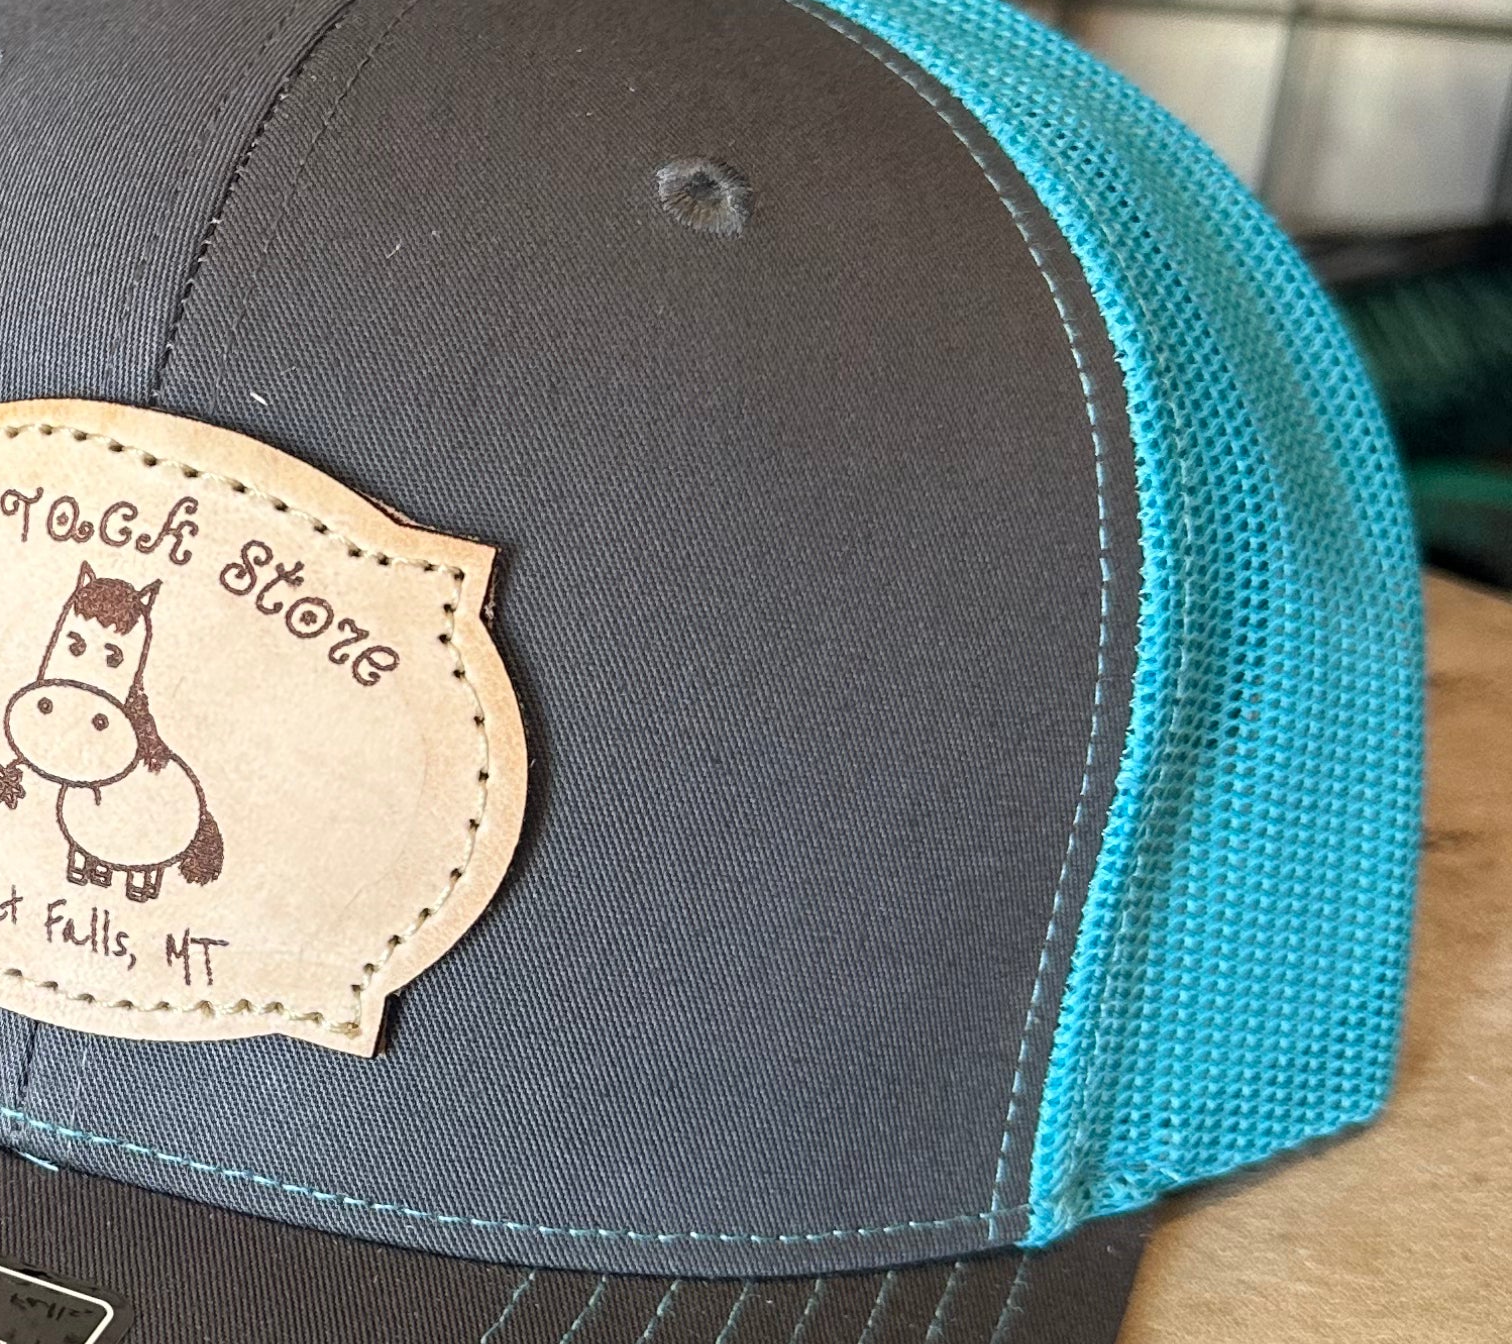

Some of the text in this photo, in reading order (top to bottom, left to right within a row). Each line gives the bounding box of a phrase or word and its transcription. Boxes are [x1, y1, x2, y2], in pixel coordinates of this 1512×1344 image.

[219, 539, 400, 687] Store
[45, 898, 136, 971] Falls,
[166, 928, 229, 985] MT
